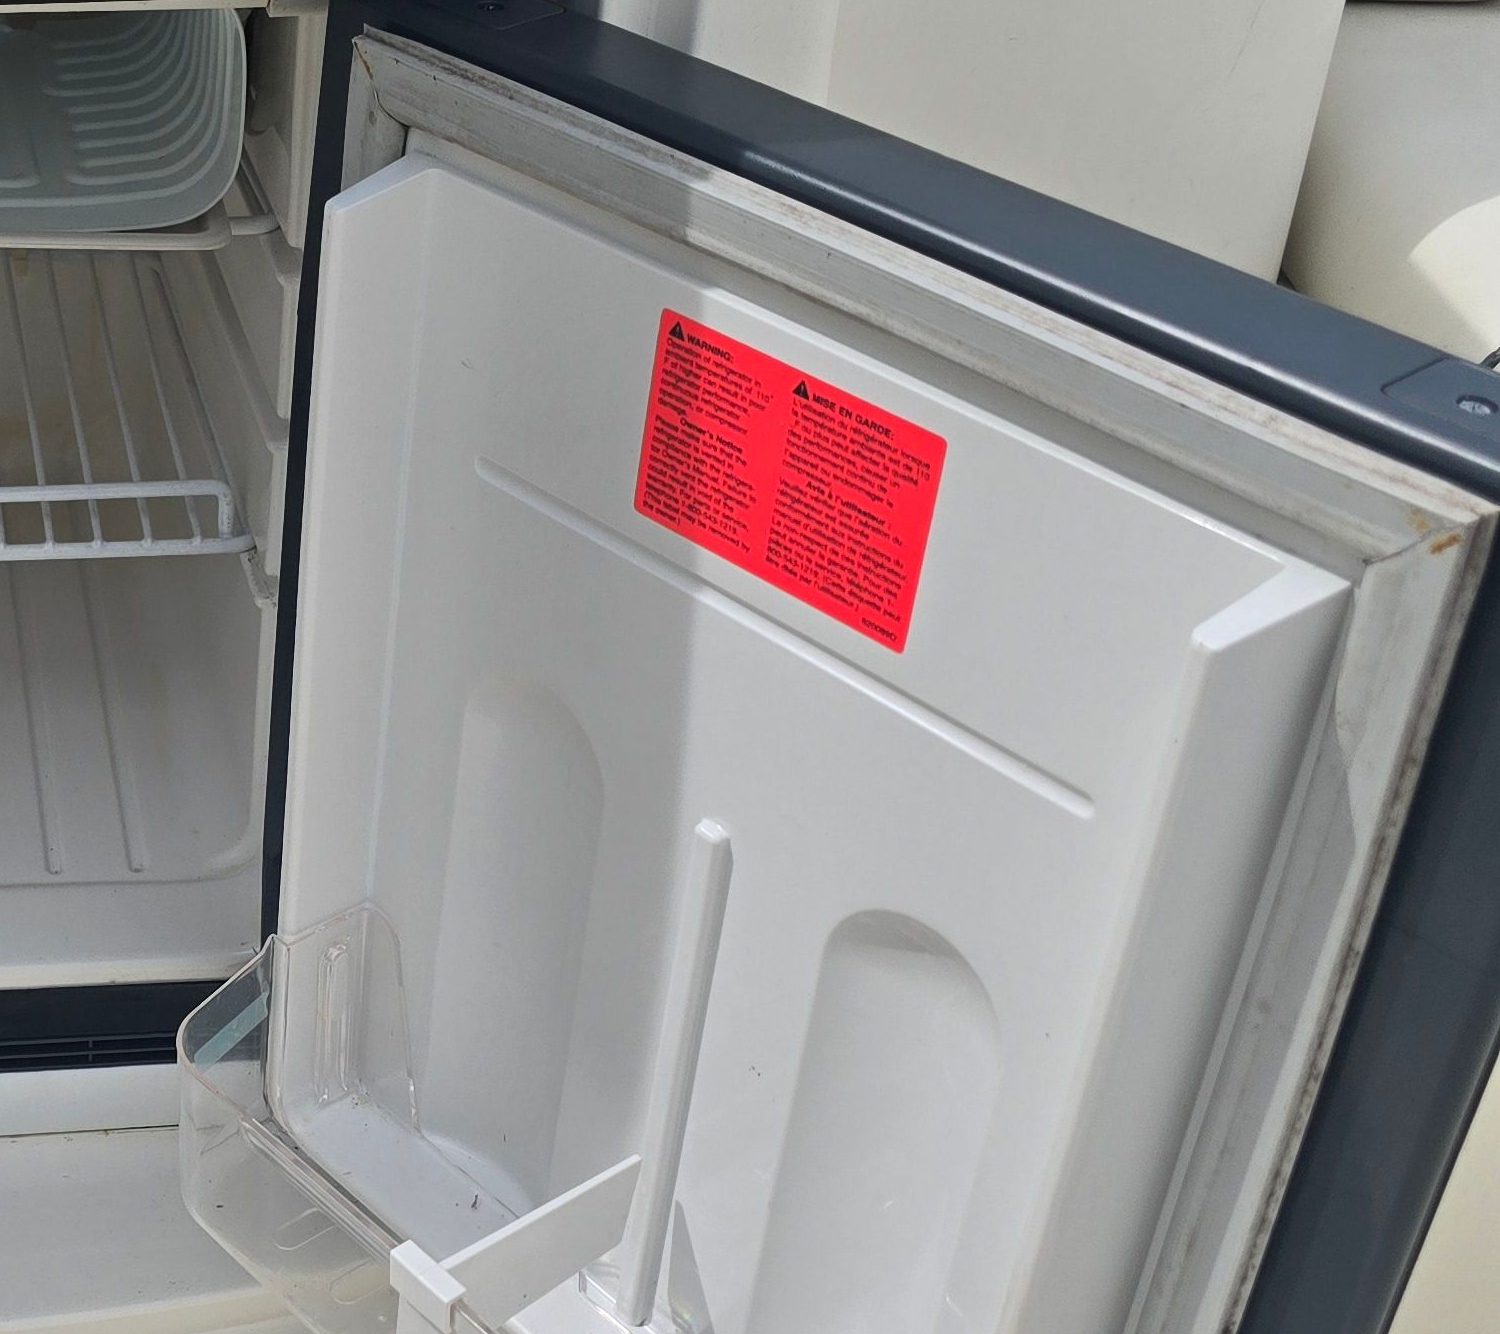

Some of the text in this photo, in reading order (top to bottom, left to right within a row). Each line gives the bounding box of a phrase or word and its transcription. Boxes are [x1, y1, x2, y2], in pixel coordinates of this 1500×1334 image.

[687, 333, 734, 363] WARNING:
[812, 393, 895, 440] MISE EN GARDE:
